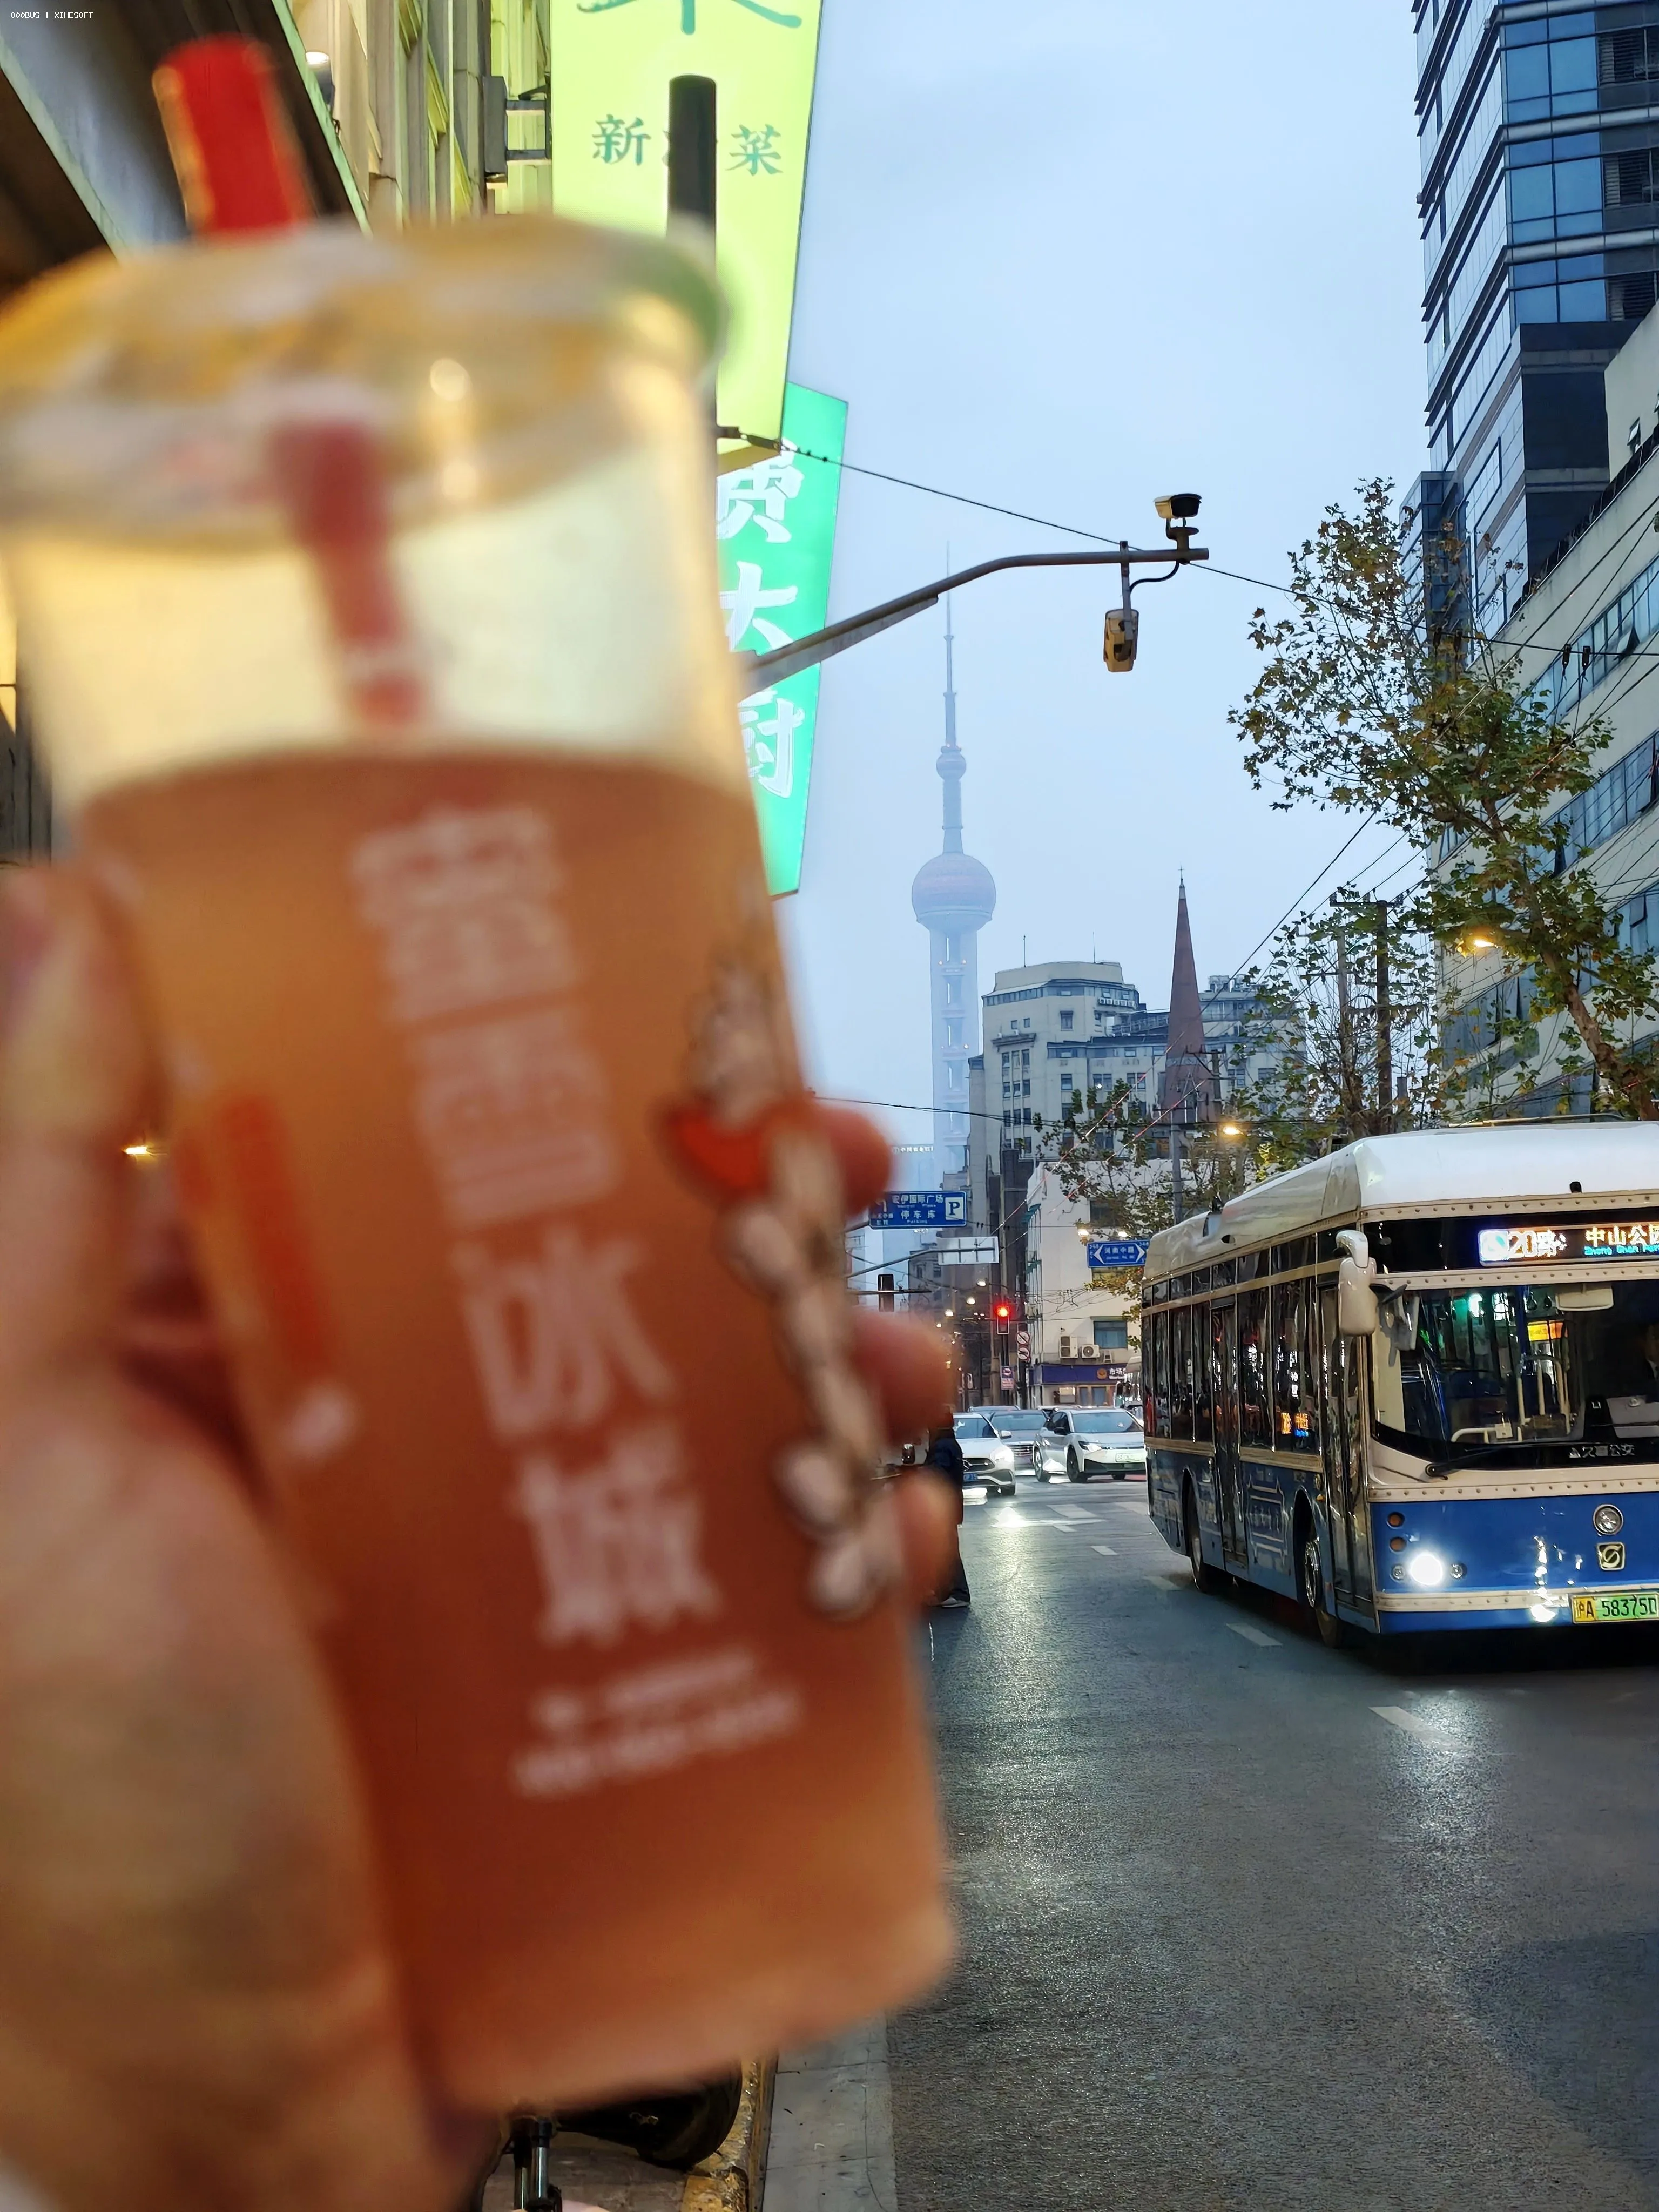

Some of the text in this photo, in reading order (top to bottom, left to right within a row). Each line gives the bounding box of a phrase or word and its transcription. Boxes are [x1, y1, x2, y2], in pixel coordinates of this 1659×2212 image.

[592, 114, 783, 176] 新菜
[948, 1202, 960, 1215] P
[1582, 1444, 1635, 1458] 久公交
